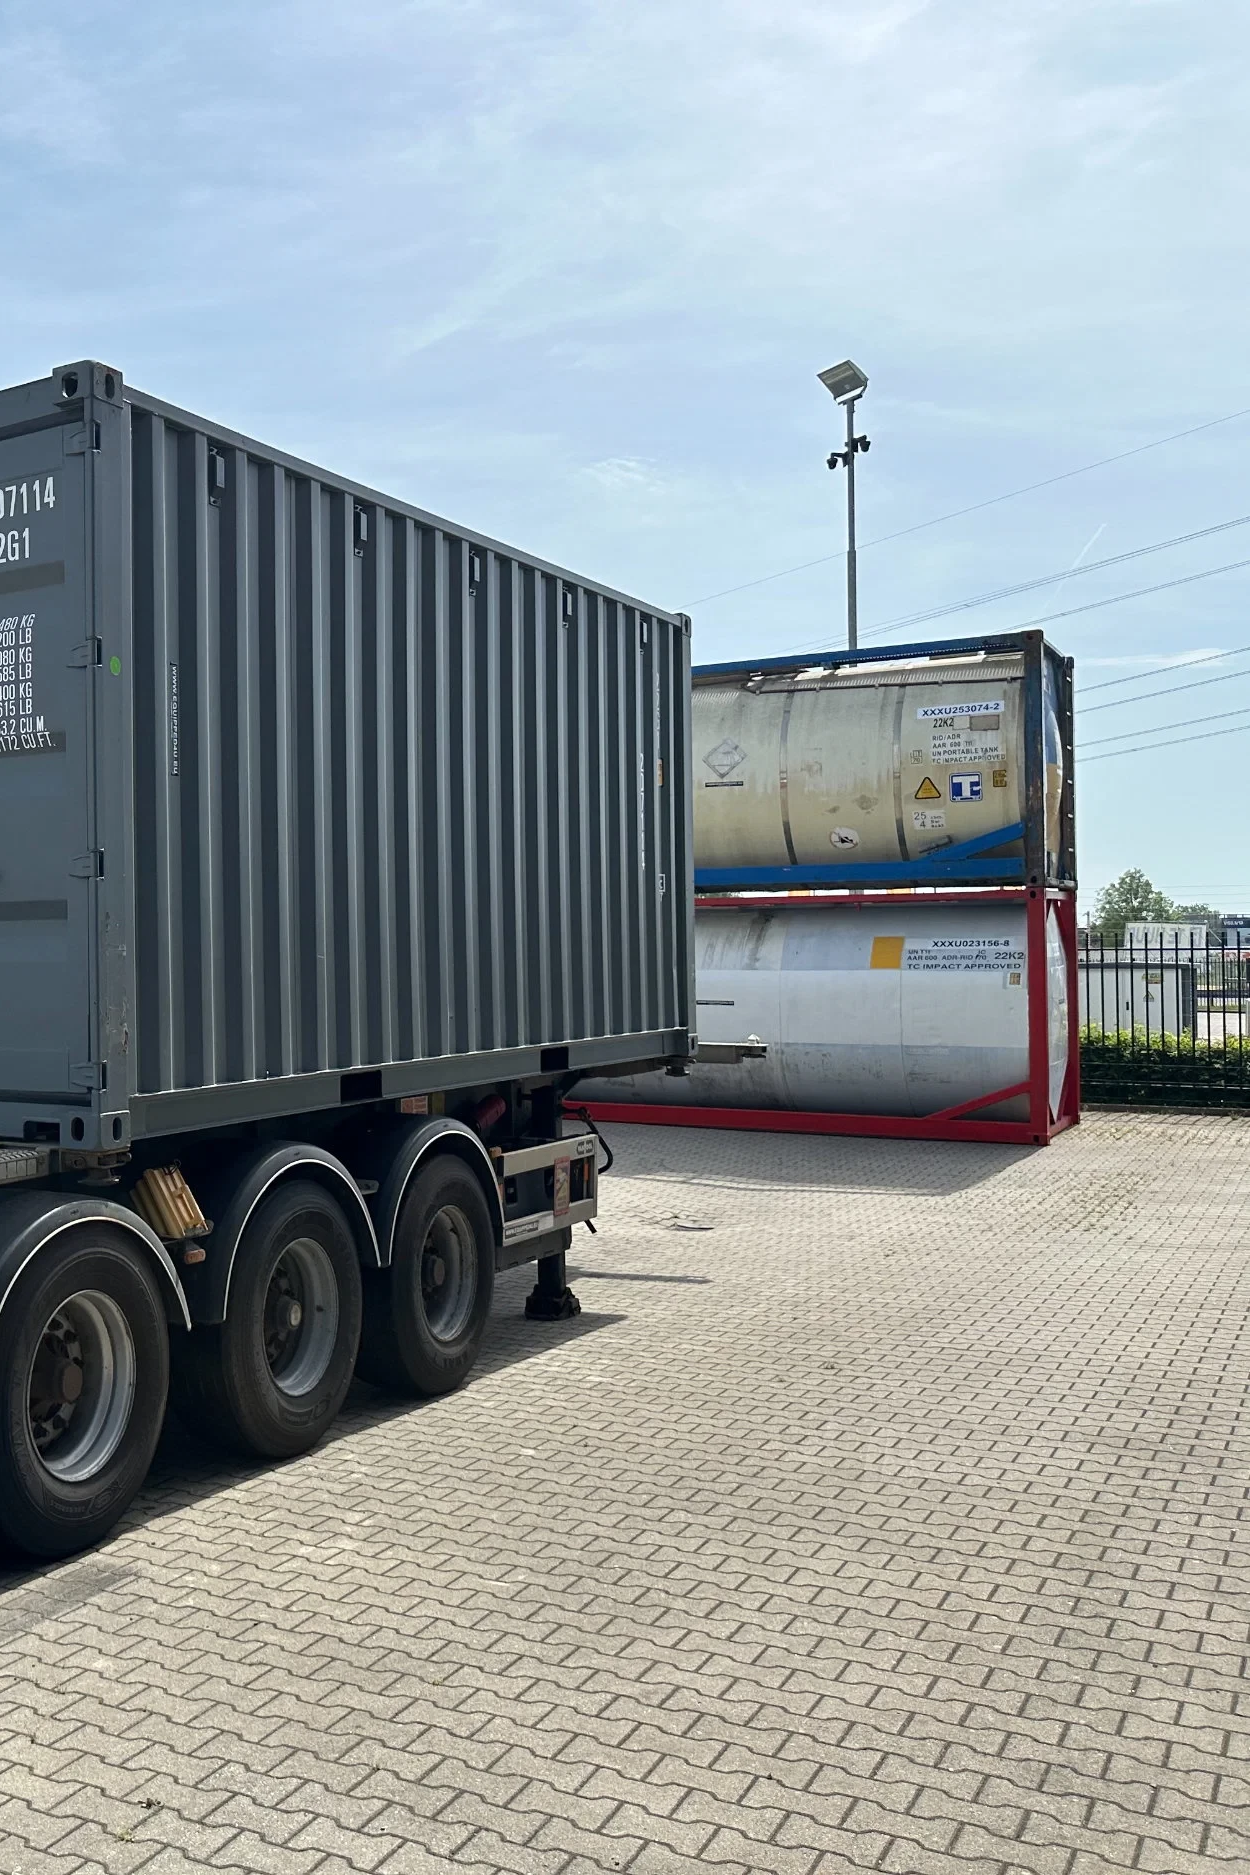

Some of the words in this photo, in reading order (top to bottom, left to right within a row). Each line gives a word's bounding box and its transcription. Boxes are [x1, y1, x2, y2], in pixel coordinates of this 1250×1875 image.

[19, 613, 35, 628] KG
[19, 627, 32, 645] LB
[19, 647, 32, 663] KG
[19, 663, 32, 680] LB
[19, 682, 32, 699] KG
[19, 698, 33, 715] LB
[922, 702, 1000, 717] XXXU253074-2
[20, 716, 47, 734] CU.M.
[933, 717, 954, 729] 22K2
[21, 731, 56, 749] CU.FT.
[932, 939, 1010, 948] XXXU023156-8
[994, 951, 1025, 960] 22K2
